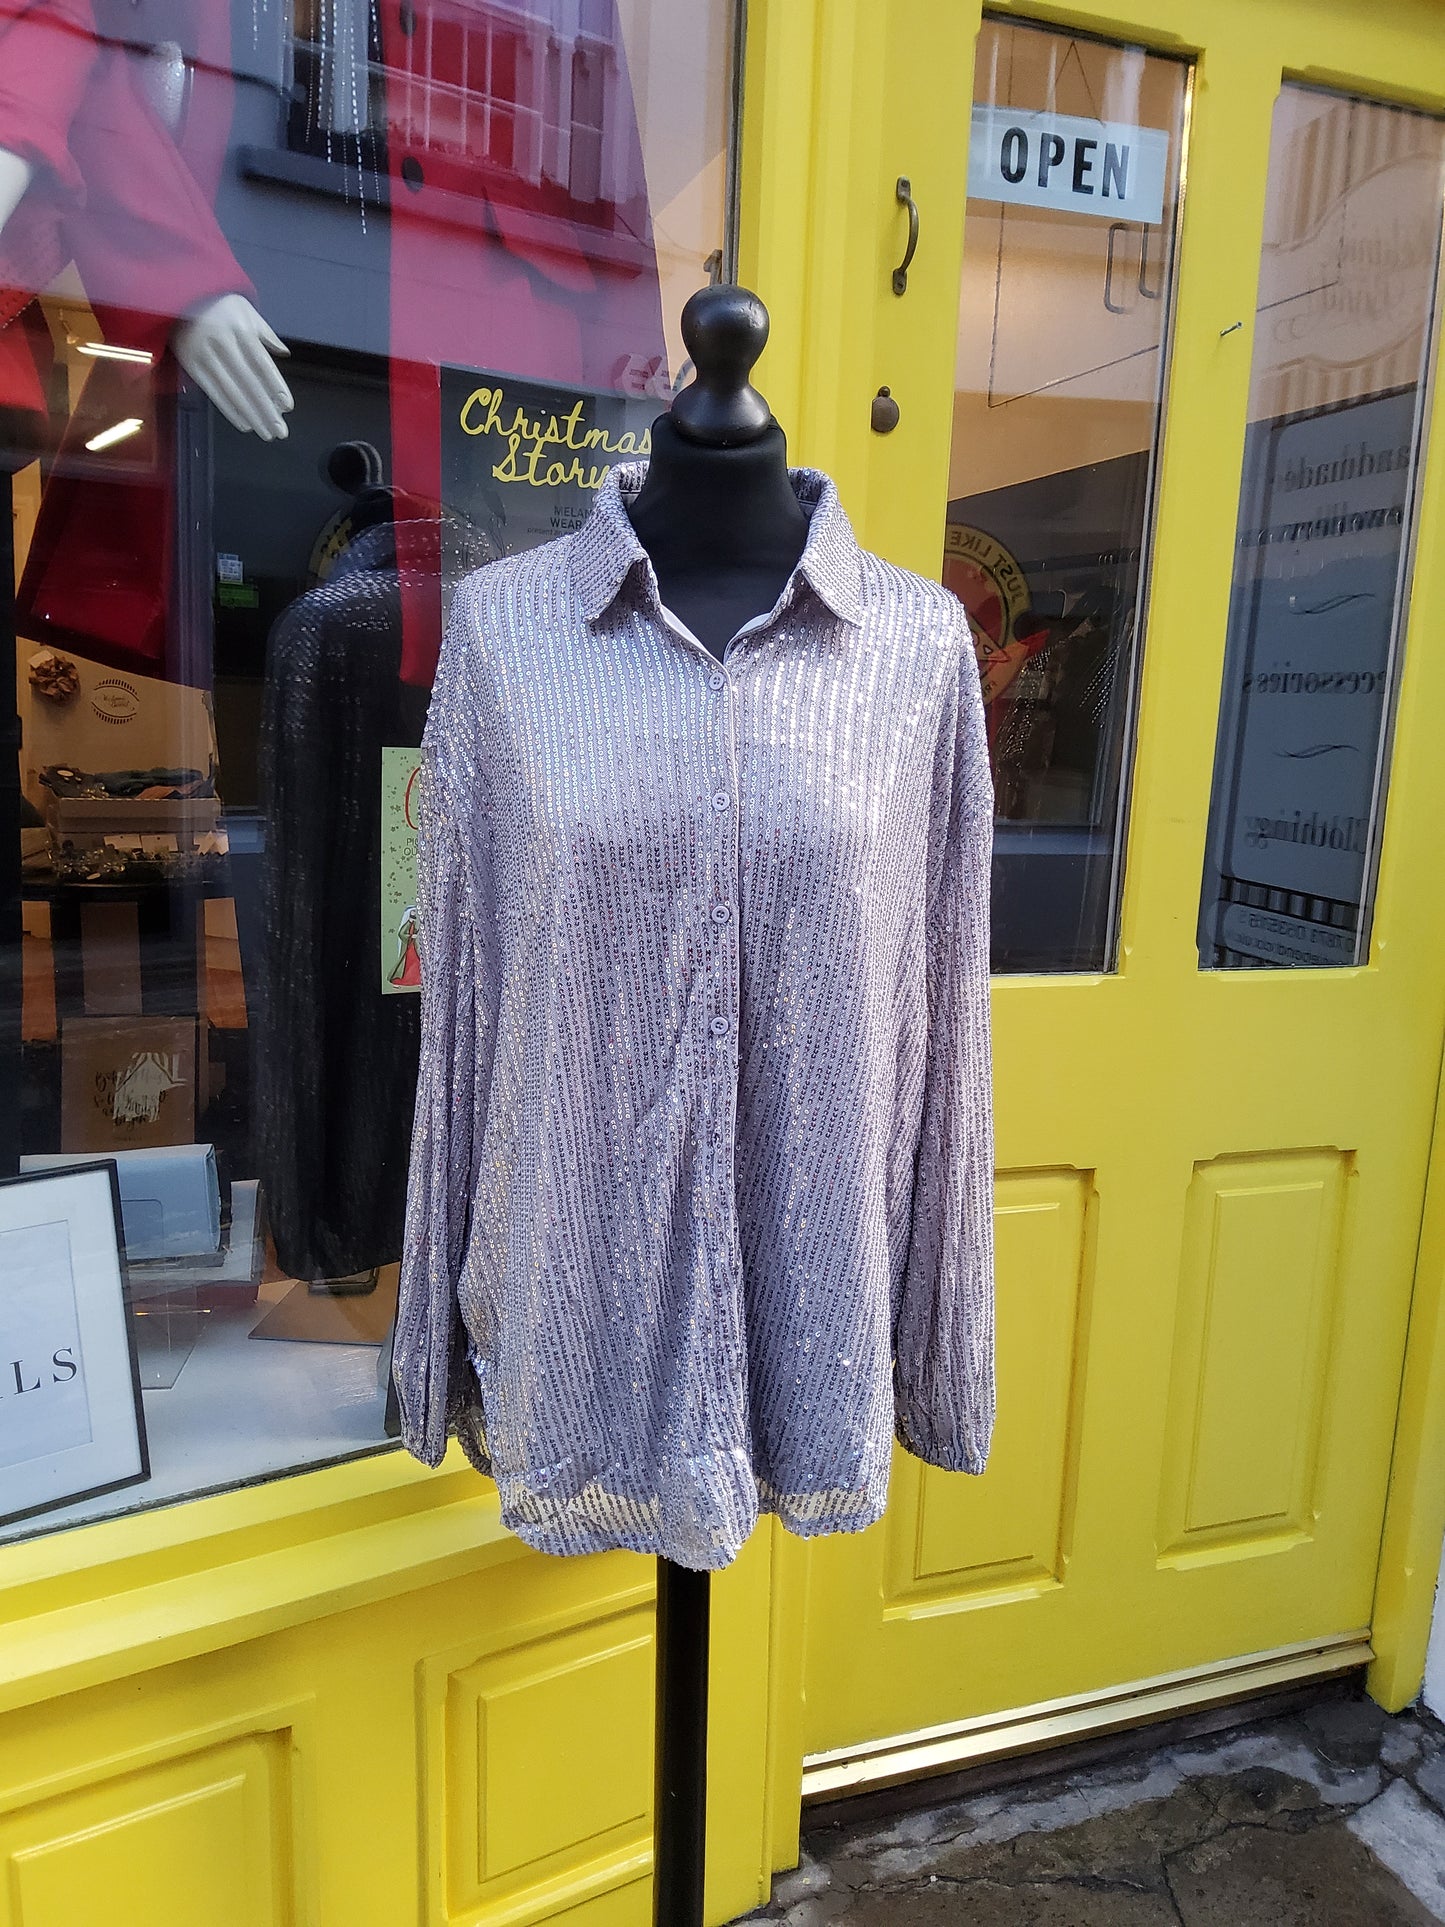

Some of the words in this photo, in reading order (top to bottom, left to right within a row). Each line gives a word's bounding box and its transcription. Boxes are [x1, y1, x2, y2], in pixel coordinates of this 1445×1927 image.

[1000, 126, 1130, 200] OPEN
[460, 388, 652, 456] Christmas
[550, 517, 582, 530] WEAR
[0, 1347, 78, 1399] LS
